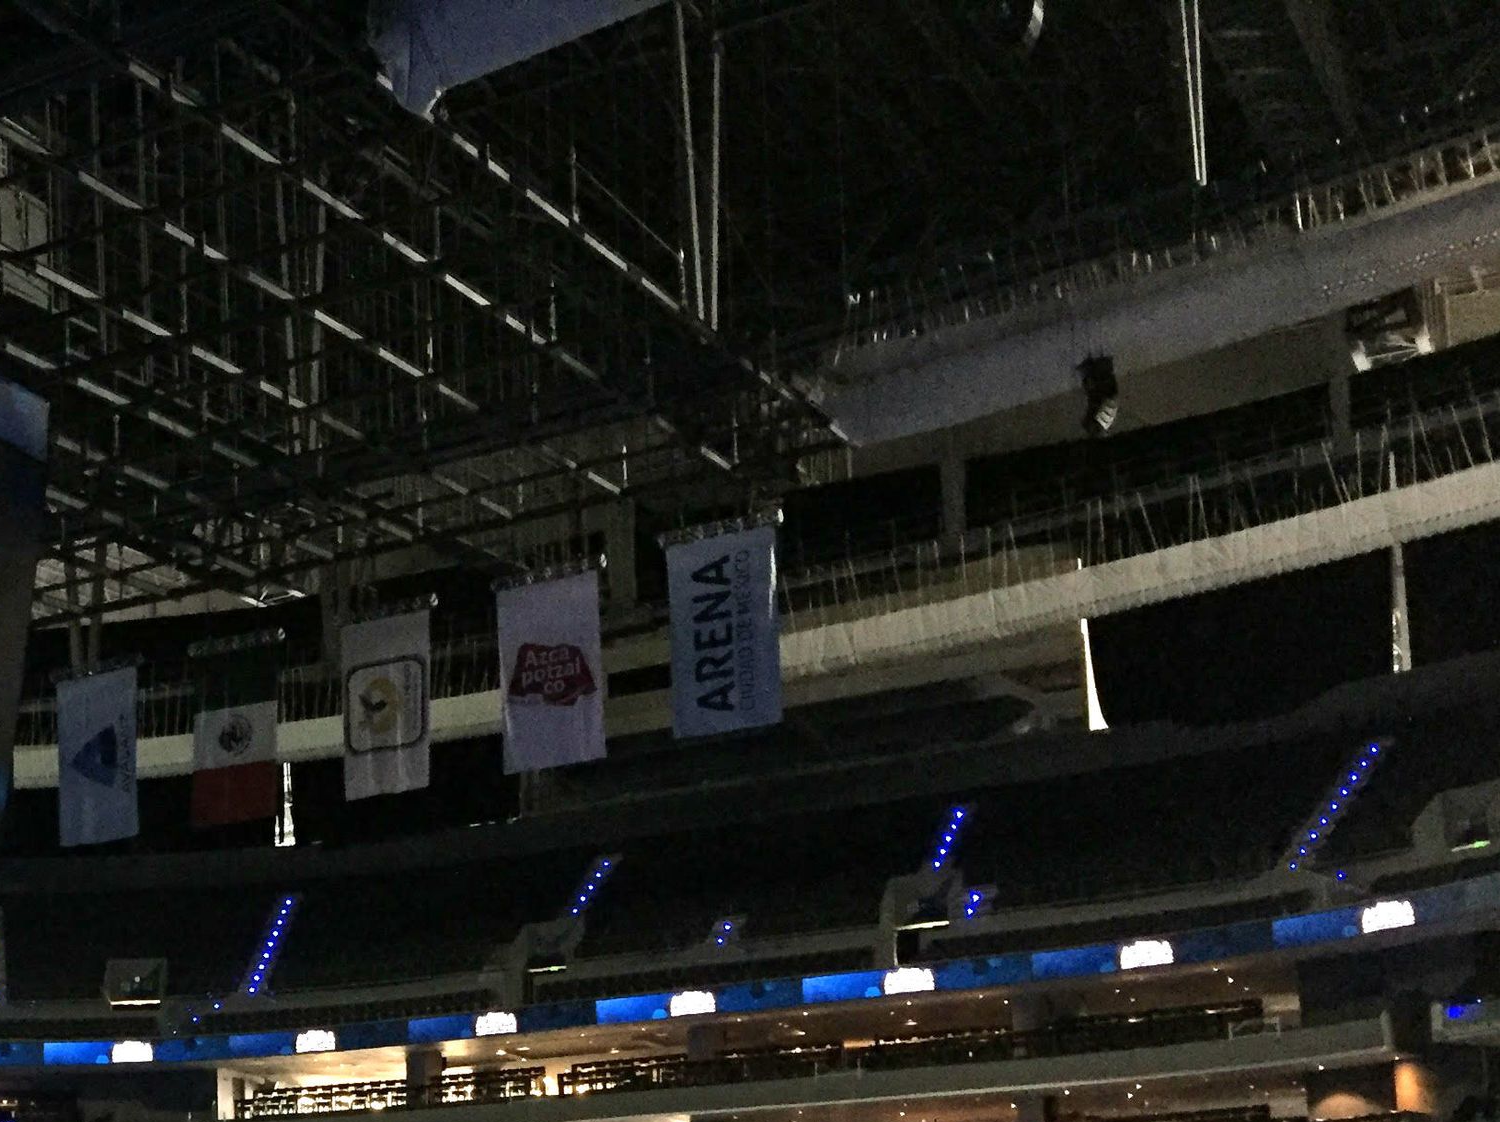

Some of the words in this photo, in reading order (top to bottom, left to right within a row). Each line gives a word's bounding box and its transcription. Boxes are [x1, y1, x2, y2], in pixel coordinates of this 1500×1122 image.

[690, 554, 735, 712] ARENA
[523, 645, 571, 669] Azca
[521, 655, 581, 688] potzal
[543, 679, 566, 694] co
